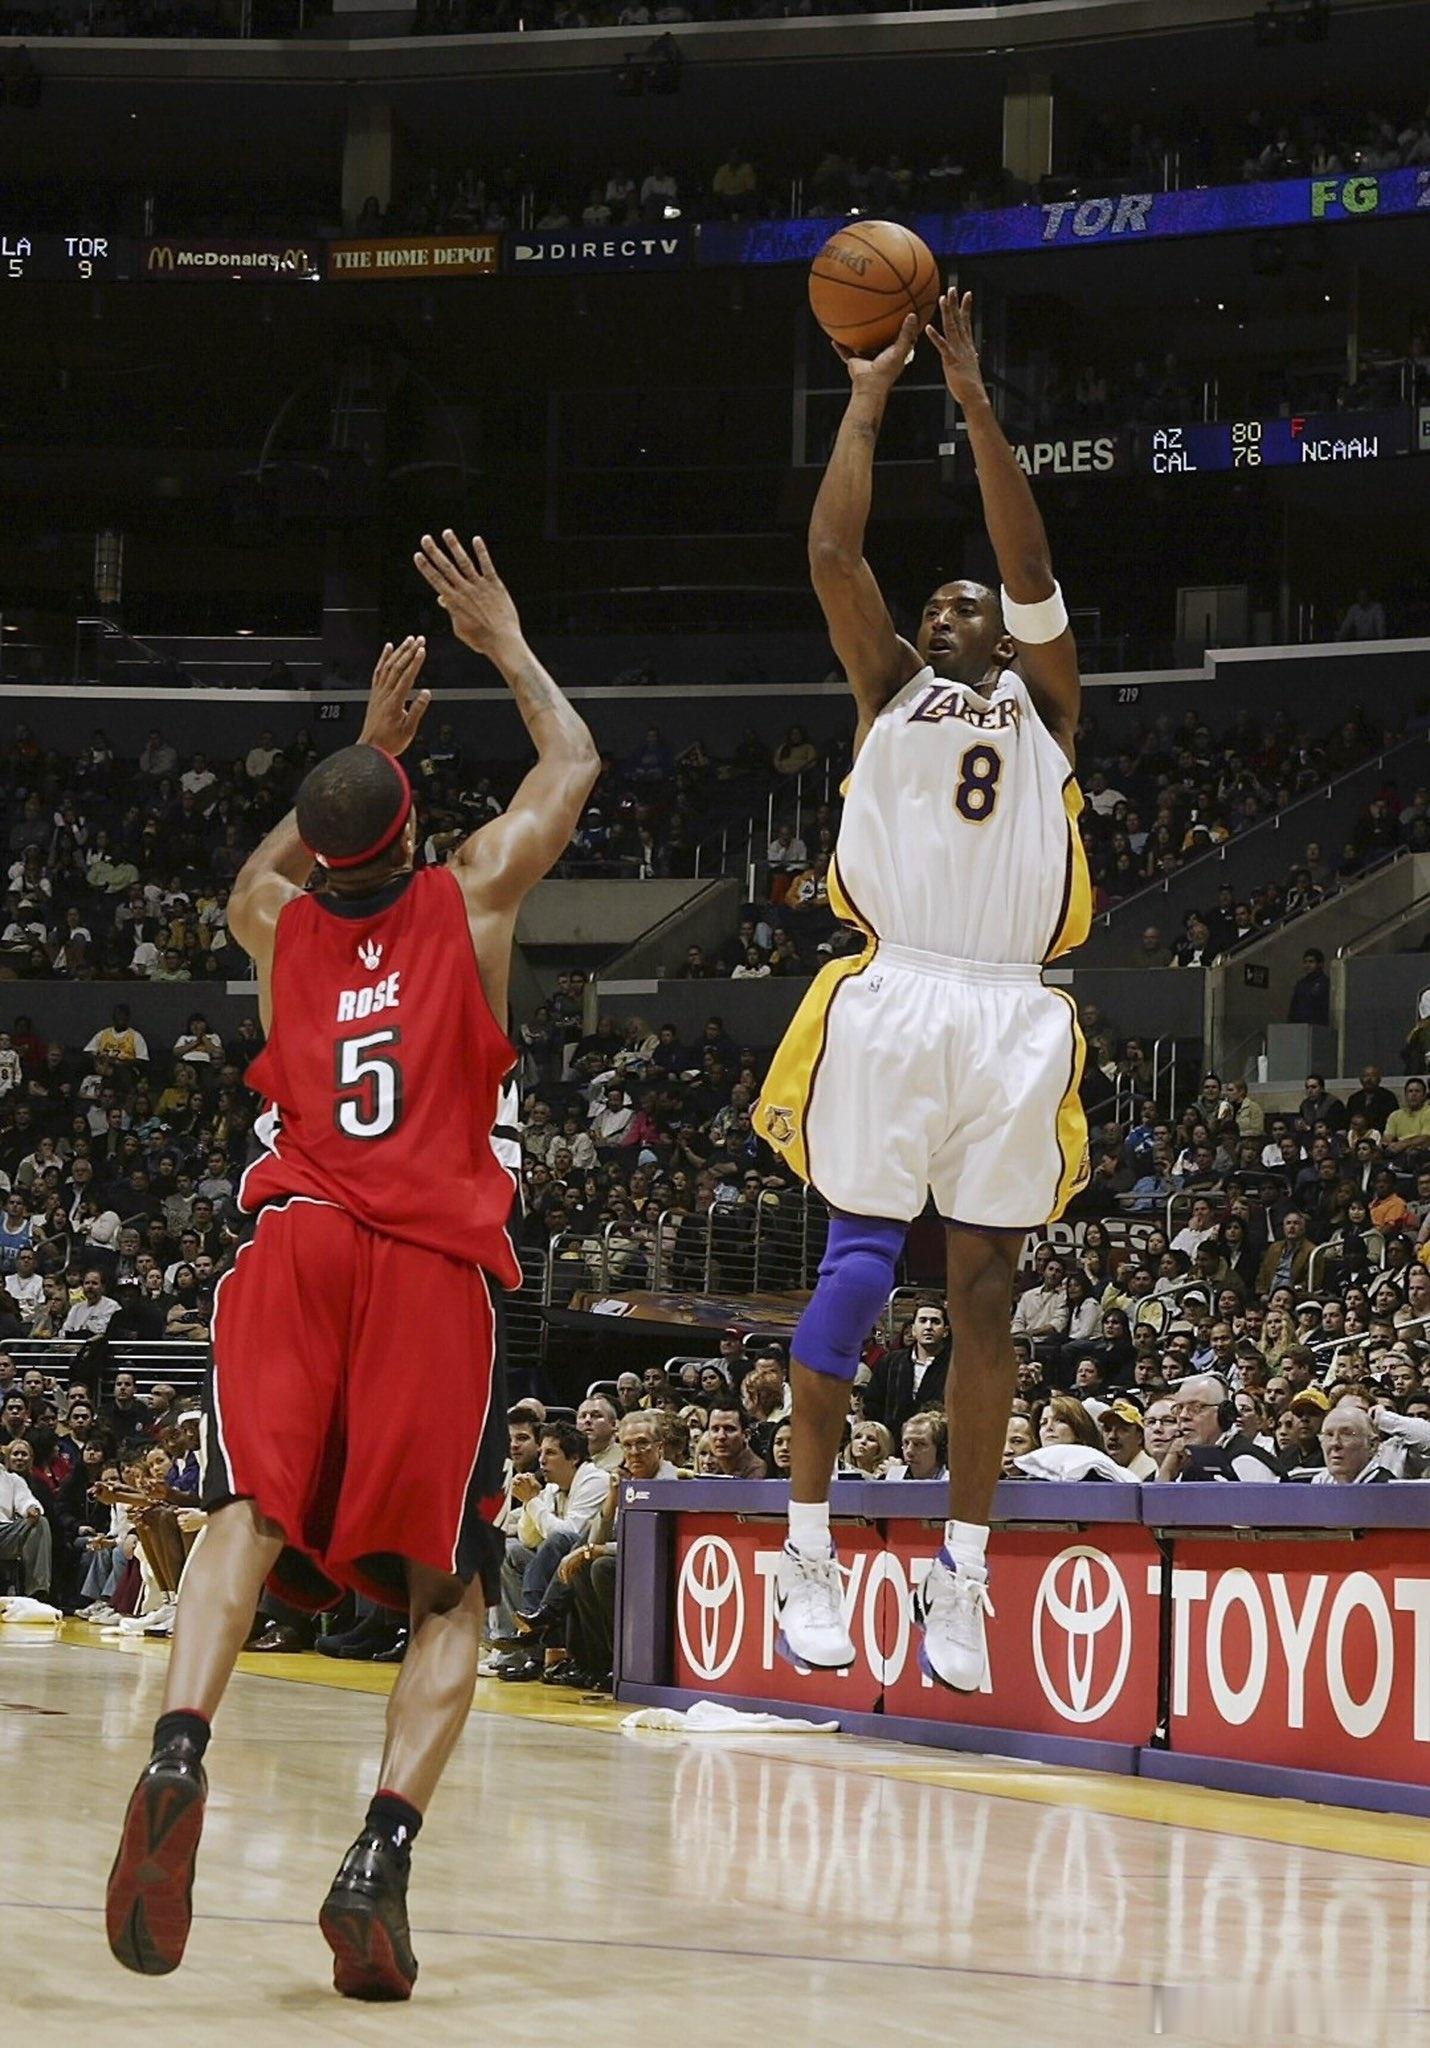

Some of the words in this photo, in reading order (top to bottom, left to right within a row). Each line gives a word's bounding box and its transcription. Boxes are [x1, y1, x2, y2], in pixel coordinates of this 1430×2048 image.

[1041, 193, 1153, 241] TOR
[1311, 176, 1378, 217] FG
[2, 236, 31, 256] LA
[64, 238, 108, 257] TOR
[176, 251, 280, 270] McDonald's
[333, 251, 372, 268] THE
[375, 249, 428, 267] HOME
[433, 246, 494, 265] DEPOT
[550, 239, 678, 260] DIRECTV
[8, 259, 23, 277] 5
[78, 260, 92, 278] 9
[1153, 428, 1182, 450] AZ
[1232, 422, 1262, 443] 80
[1291, 418, 1305, 438] F
[1009, 438, 1114, 475] APLES
[1153, 453, 1197, 474] CAL
[1232, 446, 1262, 467] 76
[1303, 436, 1378, 464] NCAAW
[1118, 687, 1138, 702] 219
[320, 704, 340, 719] 218
[953, 740, 1001, 826] 8
[336, 971, 400, 1023] ROSE
[335, 1027, 403, 1140] 5
[1147, 1564, 1430, 1742] TOYOT
